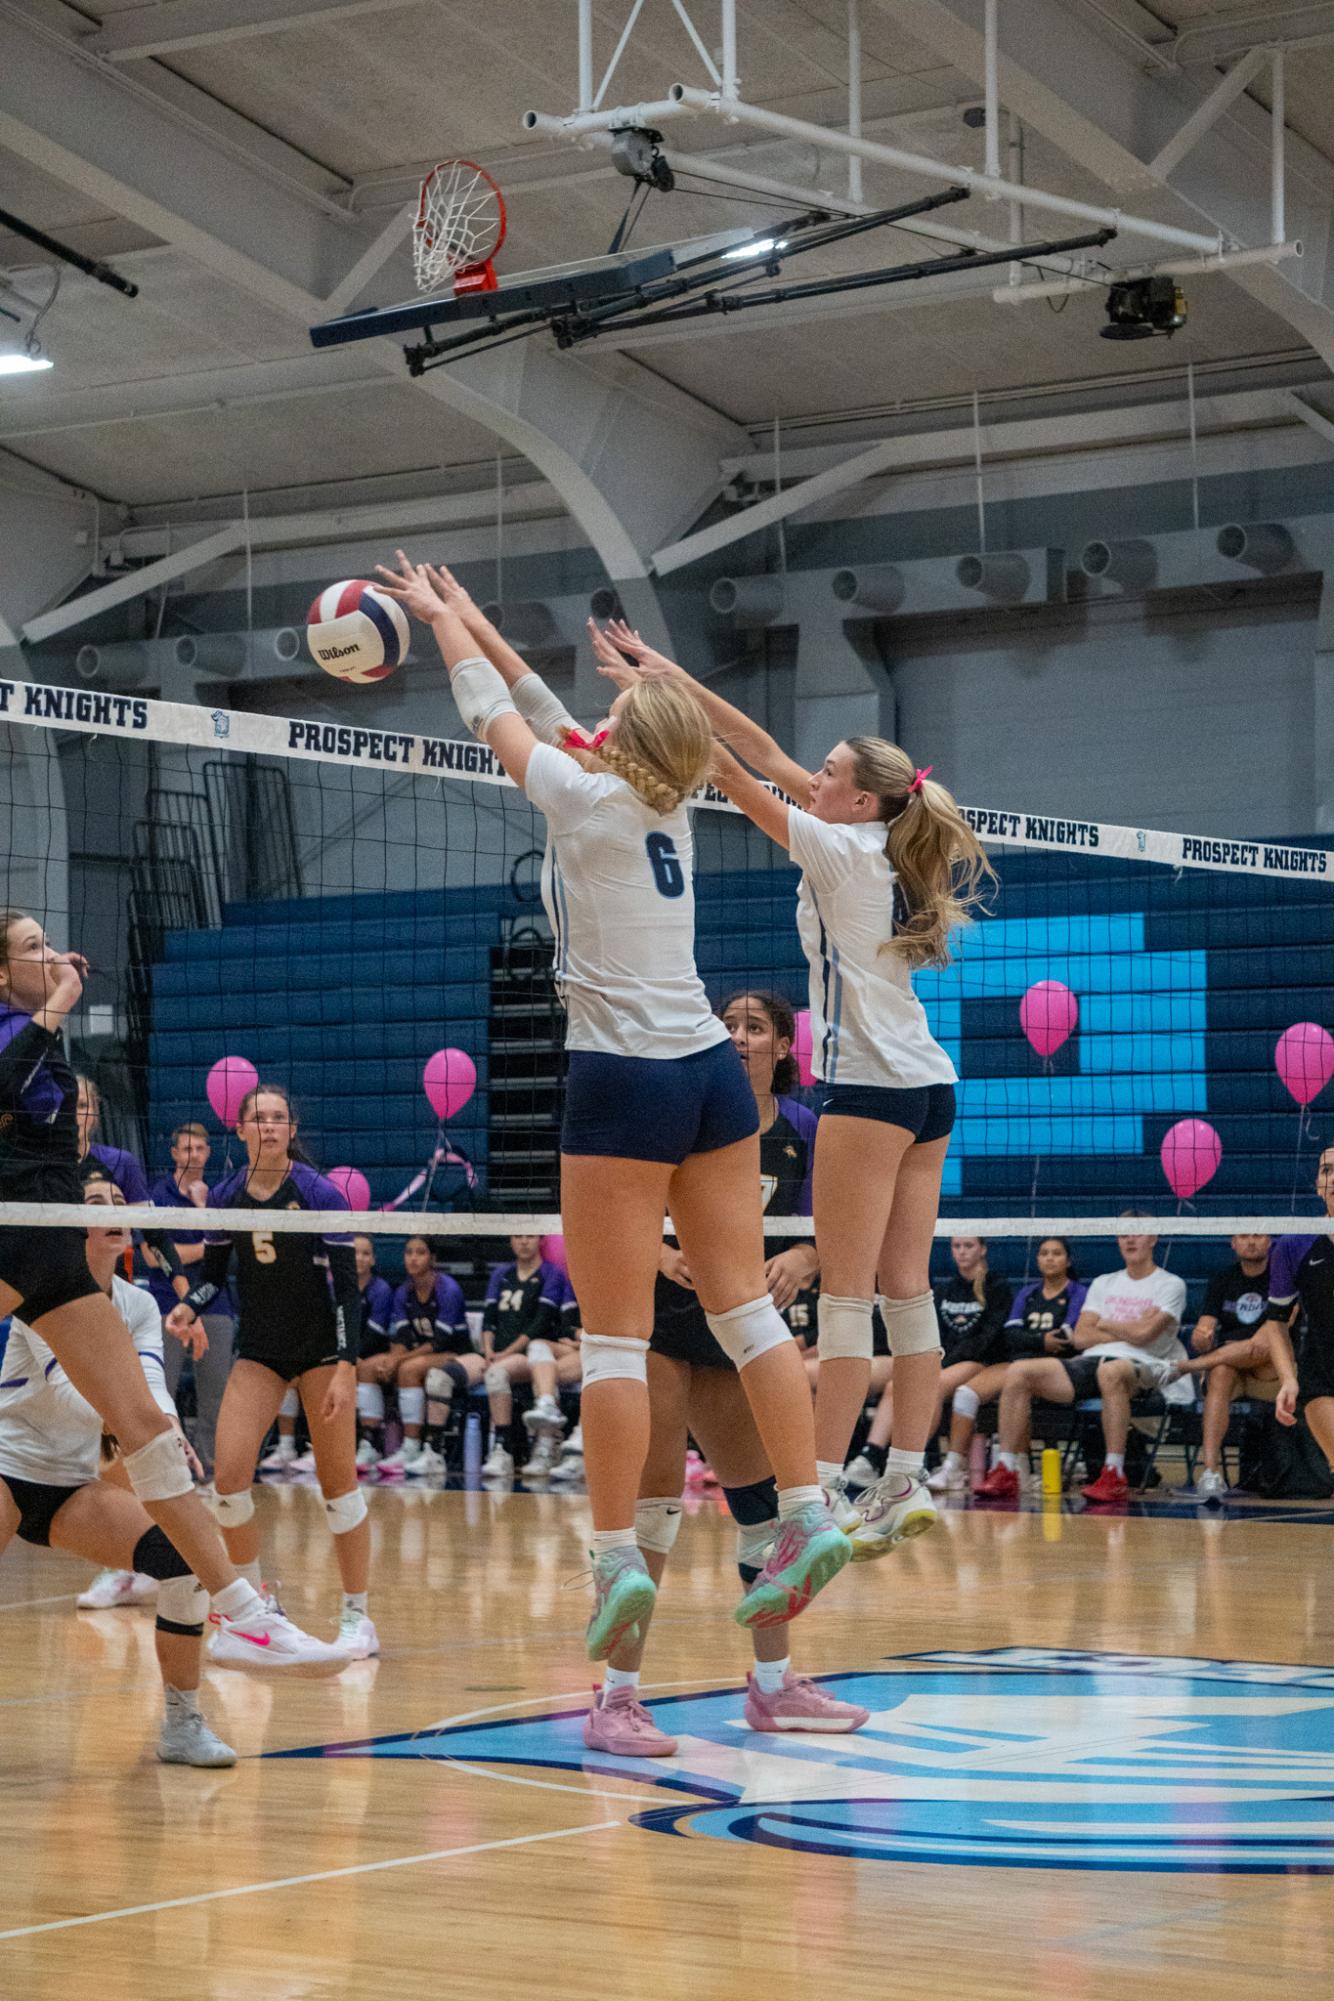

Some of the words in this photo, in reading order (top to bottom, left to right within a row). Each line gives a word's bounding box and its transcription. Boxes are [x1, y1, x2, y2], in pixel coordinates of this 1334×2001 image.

[318, 643, 360, 660] Wilson
[25, 685, 147, 729] KNIGHTS
[288, 720, 415, 763] PROSPECT
[1025, 817, 1099, 847] KNIGHTS
[645, 831, 685, 899] 6
[1182, 838, 1258, 867] PROSPECT
[1264, 847, 1327, 872] KNIGHTS
[252, 1231, 277, 1264] 5
[499, 1289, 524, 1311] 24
[789, 1303, 809, 1327] 15
